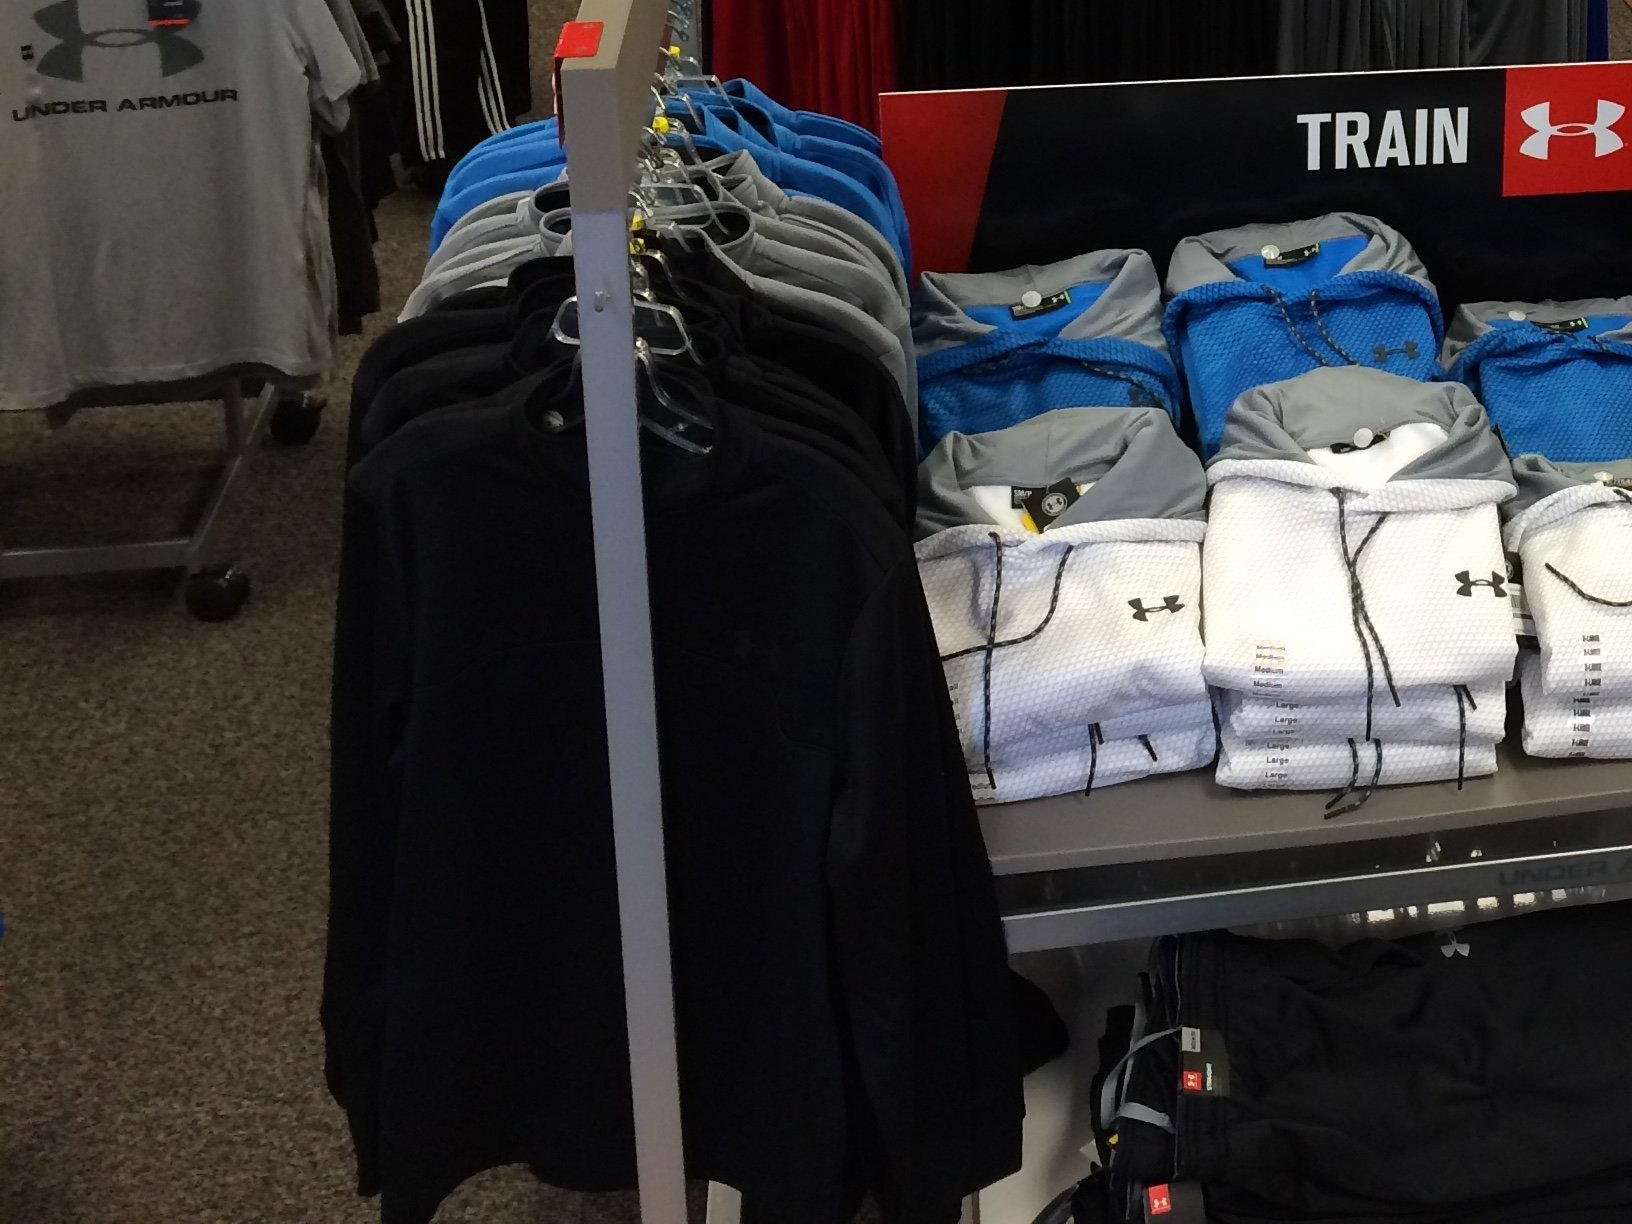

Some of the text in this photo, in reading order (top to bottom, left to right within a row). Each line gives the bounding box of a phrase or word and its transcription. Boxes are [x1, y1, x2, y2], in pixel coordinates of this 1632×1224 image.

[12, 88, 238, 122] UNDER ARMOUR
[1297, 107, 1469, 171] TRAIN
[1253, 680, 1283, 688] Medium
[1275, 701, 1299, 709] Large
[1274, 716, 1298, 724] Large
[1266, 742, 1290, 750] Large
[1266, 756, 1289, 765] Large
[1265, 771, 1288, 779] Large
[1501, 861, 1608, 886] UNDER
